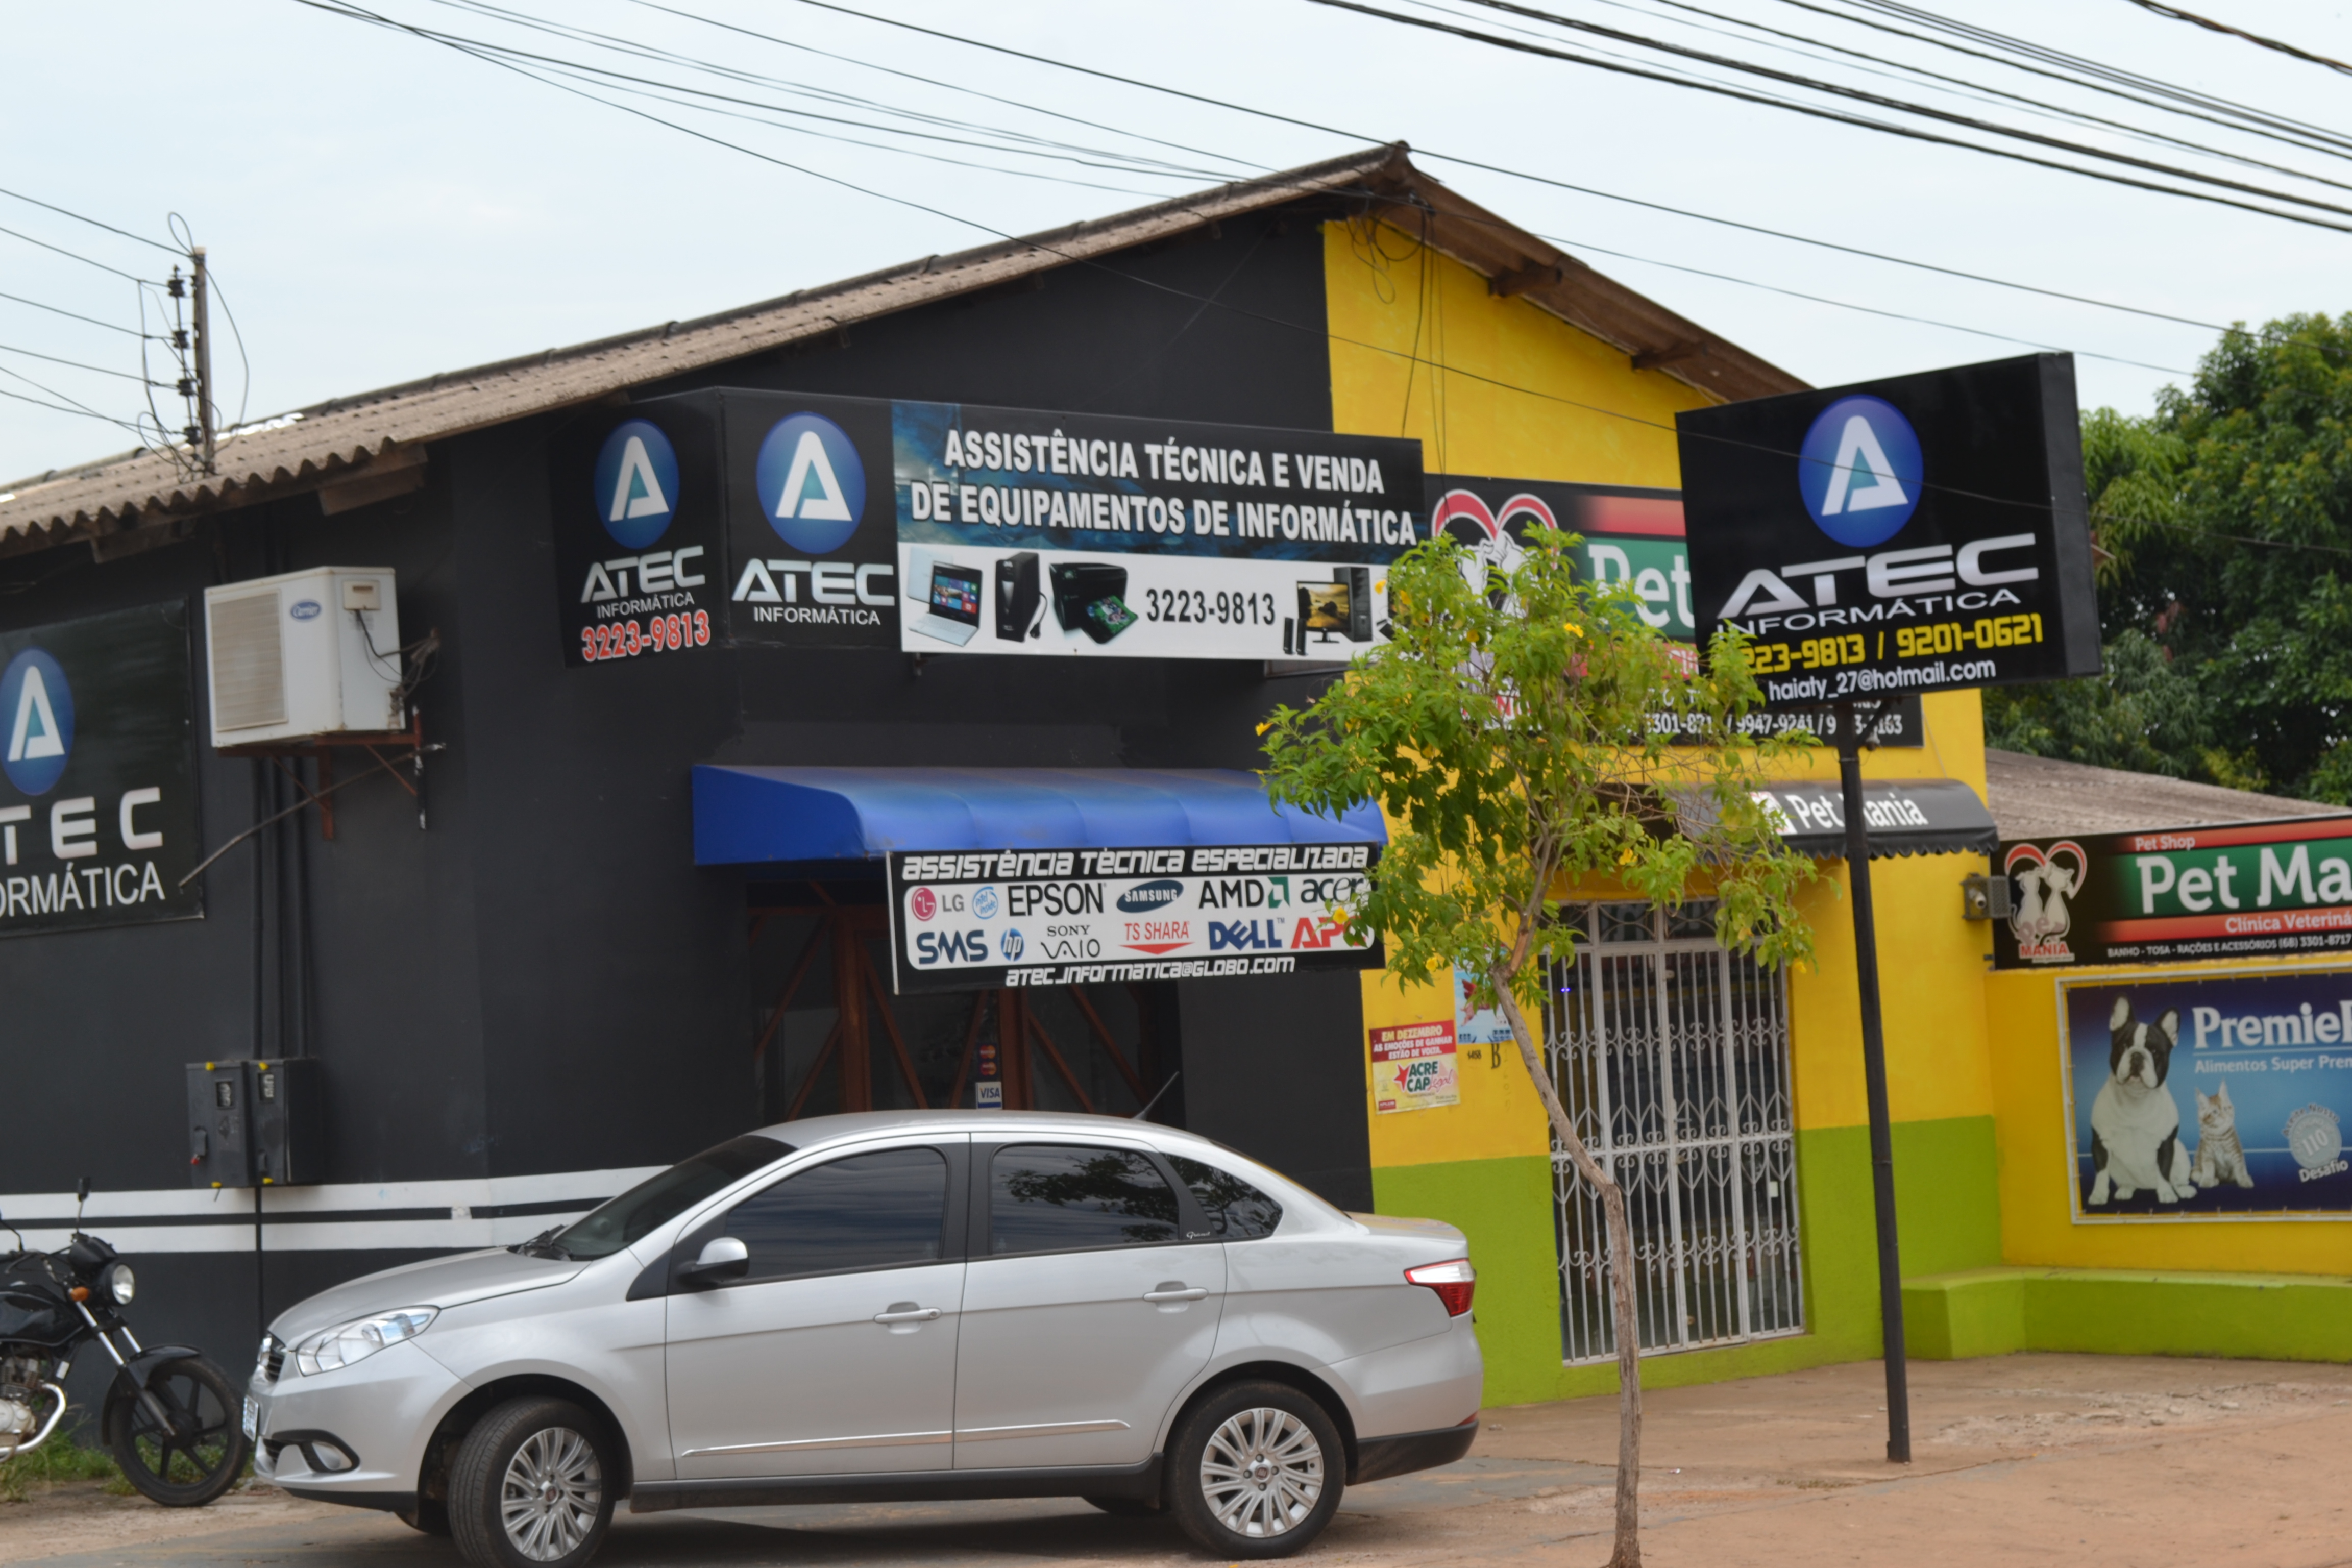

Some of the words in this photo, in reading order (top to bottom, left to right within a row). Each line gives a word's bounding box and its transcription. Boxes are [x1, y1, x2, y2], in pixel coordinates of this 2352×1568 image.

[944, 429, 1139, 478] ASSISTÊNCIA
[1144, 437, 1266, 486] TÉCNICA
[1272, 453, 1289, 487] E
[1296, 454, 1384, 494] VENDA
[911, 482, 951, 521] DE
[960, 484, 1186, 533] EQUIPAMENTOS
[1193, 499, 1230, 536] DE
[1237, 500, 1417, 546] INFORMÁTICA
[581, 545, 705, 604] ATEC
[731, 558, 895, 606] ATEC
[1588, 544, 1695, 628] Pet
[1717, 533, 2039, 619] ATEC
[597, 592, 695, 618] INFORMÁTICA
[754, 606, 880, 625] INFORMÁTICA
[1146, 589, 1275, 625] 3223-9813
[581, 610, 710, 662] 3223-9813
[1877, 631, 1884, 660] /
[1896, 613, 2043, 658] 9201-0621
[1769, 659, 1996, 701] haiaty_27@hotmail.com
[1786, 794, 1844, 829] Pet
[1840, 793, 1928, 827] ania
[2135, 837, 2158, 851] Pet
[2160, 836, 2195, 851] Shop
[1125, 887, 1177, 902] SAMSUNG
[1199, 879, 1264, 909] AMD
[1301, 878, 1364, 903] acer
[2136, 855, 2239, 914] Pet
[942, 894, 964, 912] LG
[1008, 883, 1104, 917] EPSON
[1047, 925, 1090, 937] SONY
[1124, 923, 1140, 941] TS
[1144, 921, 1189, 940] SHARA
[1208, 919, 1282, 951] DELL
[1290, 916, 1366, 949] AP
[2225, 916, 2281, 933] Clínica
[916, 929, 989, 964] SMS
[1004, 928, 1021, 961] hp
[1041, 939, 1100, 959] VAIO
[2020, 943, 2068, 957] MANIA
[2107, 947, 2139, 957] BANHO
[2146, 945, 2170, 955] TOSA
[2177, 942, 2213, 955] RAÇÕES
[2214, 943, 2220, 952] E
[2221, 939, 2277, 952] ACESSÓRIOS
[2278, 937, 2298, 949] (68)
[1382, 1031, 1395, 1042] EM
[1396, 1025, 1443, 1040] DEZEMBRO
[1384, 1039, 1414, 1051] EMOÇÕES
[1415, 1039, 1424, 1048] DE
[1425, 1036, 1453, 1046] GANHAR
[1388, 1048, 1410, 1060] ESTÃO
[1412, 1048, 1420, 1057] DE
[2195, 1059, 2267, 1073] Alimentos
[2271, 1056, 2314, 1073] Super
[1409, 1061, 1438, 1077] ACRE
[980, 1088, 1000, 1099] VISA
[1407, 1076, 1431, 1092] CAP
[2299, 1159, 2349, 1183] Desafio
